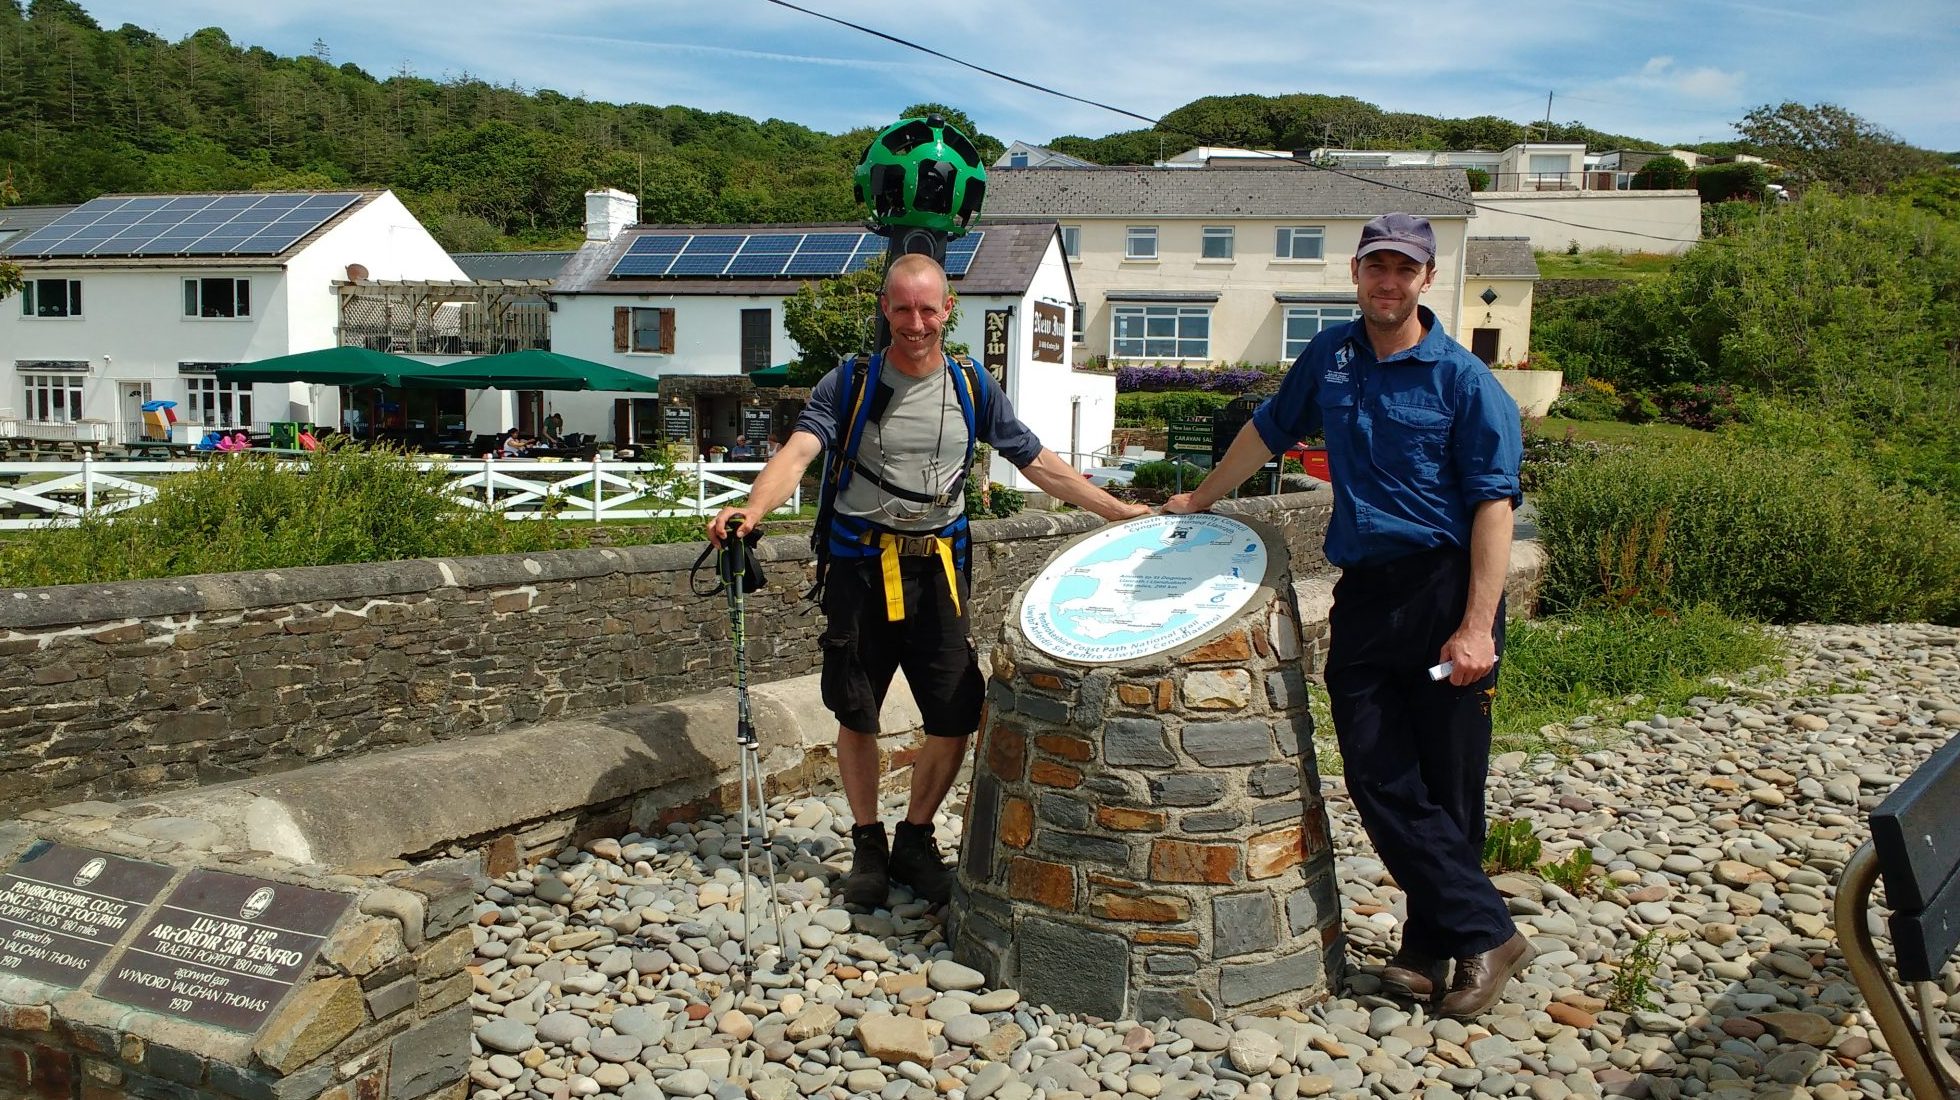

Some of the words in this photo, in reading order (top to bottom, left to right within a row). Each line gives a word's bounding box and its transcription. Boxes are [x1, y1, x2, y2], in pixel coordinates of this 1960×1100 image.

[986, 312, 1008, 355] New
[1033, 311, 1052, 335] New
[1052, 314, 1065, 337] Inn
[1174, 435, 1201, 443] CARAVAN
[1123, 515, 1162, 529] Amroth
[1072, 642, 1101, 653] Coast
[1102, 645, 1128, 653] Path
[1130, 627, 1178, 650] National
[1179, 619, 1201, 634] Trail
[1107, 645, 1149, 659] Llwybr
[10, 881, 92, 908] PEMBROKESHIRE
[89, 899, 129, 916] COAST
[21, 895, 74, 917] DSTANCE
[69, 908, 128, 930] FOOTPATH
[0, 903, 31, 919] POPPIT
[27, 910, 62, 927] SANDS
[60, 919, 79, 932] 180
[76, 923, 100, 937] miles
[190, 917, 248, 942] LLWYBR
[12, 928, 44, 943] opened
[41, 932, 55, 947] by
[148, 923, 223, 951] ARFORDIR
[219, 939, 247, 956] SIR
[245, 944, 303, 967] BENFRO
[0, 954, 22, 969] 1970
[4, 938, 51, 960] VAUGHAN
[47, 950, 91, 970] THOMAS
[154, 940, 195, 960] TRAETH
[194, 949, 234, 968] POPPIT
[232, 957, 253, 970] 180
[117, 967, 171, 990] WYNFORD
[170, 980, 226, 1003] VAUGHAN
[222, 992, 270, 1012] THOMAS
[173, 966, 214, 987] agorwyd
[211, 975, 231, 988] gan
[168, 996, 193, 1012] 1970
